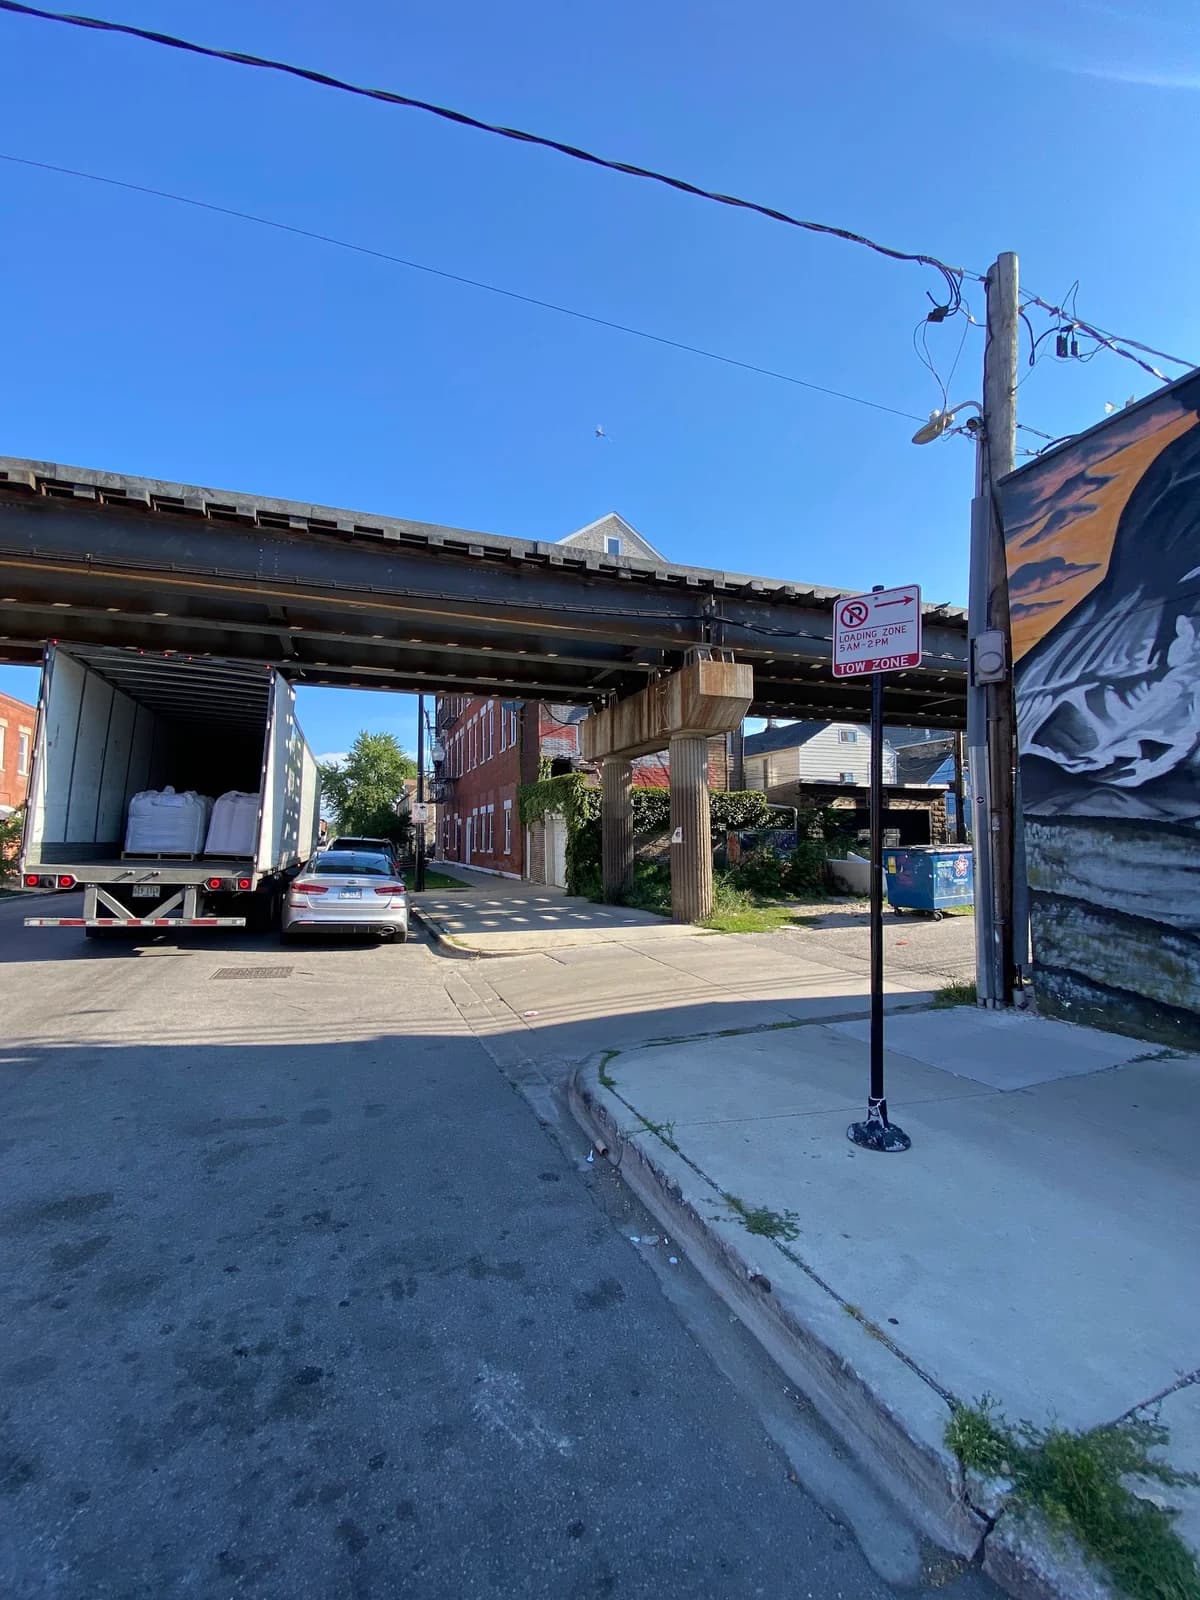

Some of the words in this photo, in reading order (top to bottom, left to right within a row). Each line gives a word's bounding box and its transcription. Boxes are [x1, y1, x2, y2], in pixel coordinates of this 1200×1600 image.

[840, 630, 877, 643] LOADING
[882, 625, 907, 636] ZONE
[840, 662, 866, 674] TOW
[872, 656, 909, 670] ZONE
